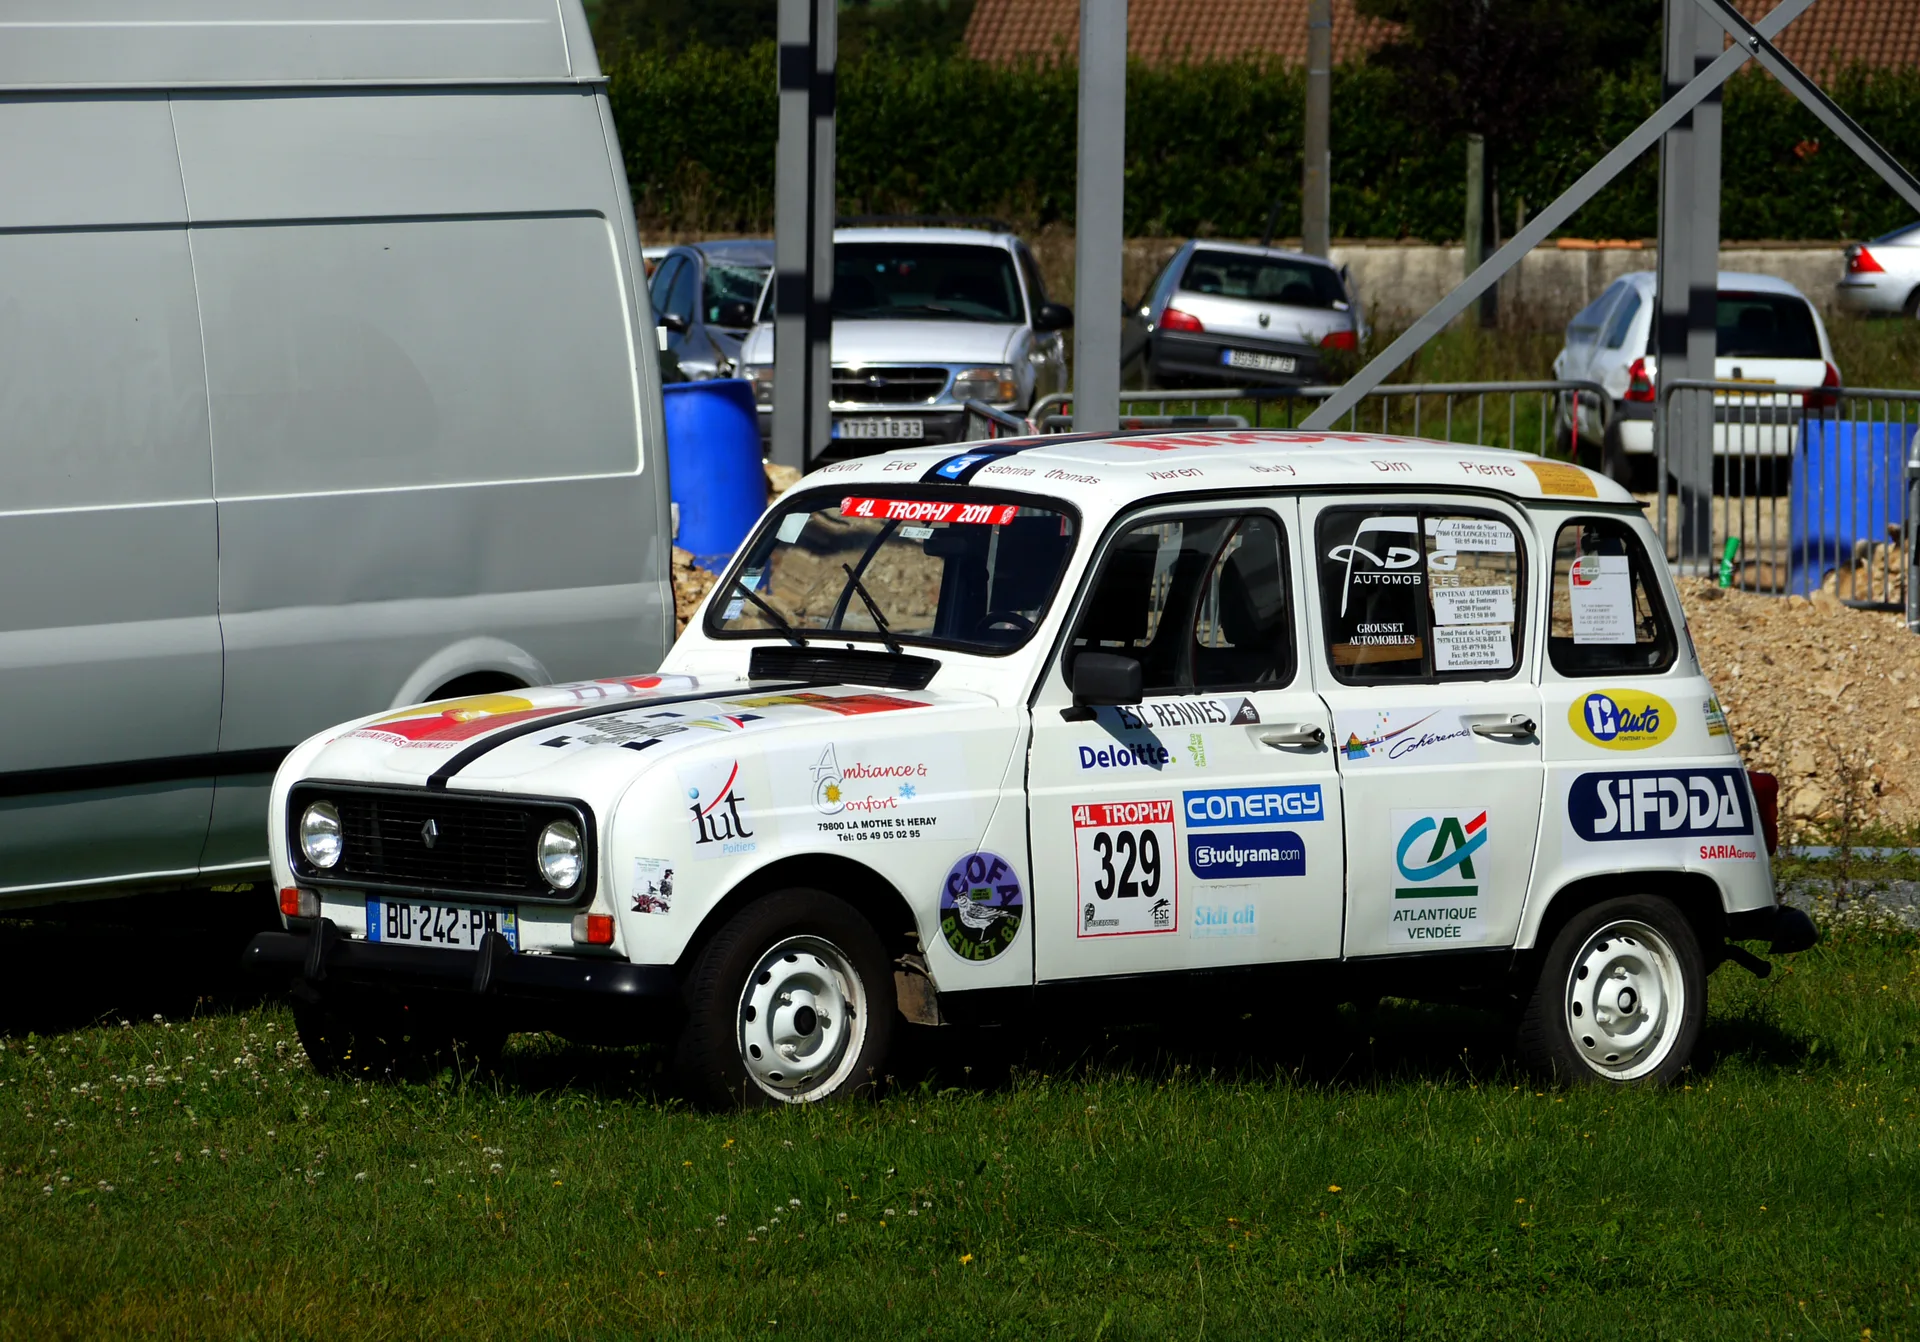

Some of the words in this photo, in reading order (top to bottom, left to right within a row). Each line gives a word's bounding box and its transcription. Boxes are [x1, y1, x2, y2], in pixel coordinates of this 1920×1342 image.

[903, 422, 920, 437] 33
[882, 460, 918, 471] Eve
[984, 465, 1036, 477] sabrina
[1370, 460, 1412, 472] Dim
[1459, 461, 1516, 477] Pierre
[1044, 468, 1101, 485] thomas
[855, 499, 875, 517] 4L
[885, 502, 954, 521] TROPHY
[957, 504, 994, 523] 2011
[1354, 574, 1460, 587] AUTOMOBLES
[1476, 597, 1498, 605] Fontenay
[1357, 623, 1404, 633] GROUSSET
[1349, 635, 1415, 646] AUTOMOBILES
[1115, 704, 1153, 730] ESC
[1151, 700, 1227, 727] RENNES
[809, 742, 915, 783] Ambiance
[917, 763, 928, 777] &
[811, 773, 898, 815] Confort
[688, 787, 753, 844] iut
[1074, 805, 1097, 825] 4L
[1102, 801, 1171, 824] TROPHY
[817, 821, 845, 831] 79800
[847, 821, 859, 829] LA
[861, 819, 893, 829] MOTHE
[895, 818, 905, 827] St
[907, 817, 937, 826] HERAY
[837, 833, 854, 842] Tél:
[856, 832, 868, 841] 05
[869, 832, 881, 840] 49
[883, 831, 894, 839] 05
[896, 830, 907, 839] 02
[909, 829, 920, 838] 95
[722, 842, 756, 854] Poitiers
[1198, 845, 1300, 868] Studyrama.com
[1093, 829, 1161, 900] 329
[947, 855, 1020, 907] COFA
[1154, 909, 1169, 920] ESC
[1194, 904, 1228, 926] Sidi
[1233, 903, 1255, 924] ali
[1393, 907, 1477, 921] ATLANTIQUE
[371, 922, 376, 933] F
[1407, 924, 1462, 939] VENDÉE
[942, 915, 997, 960] BENET
